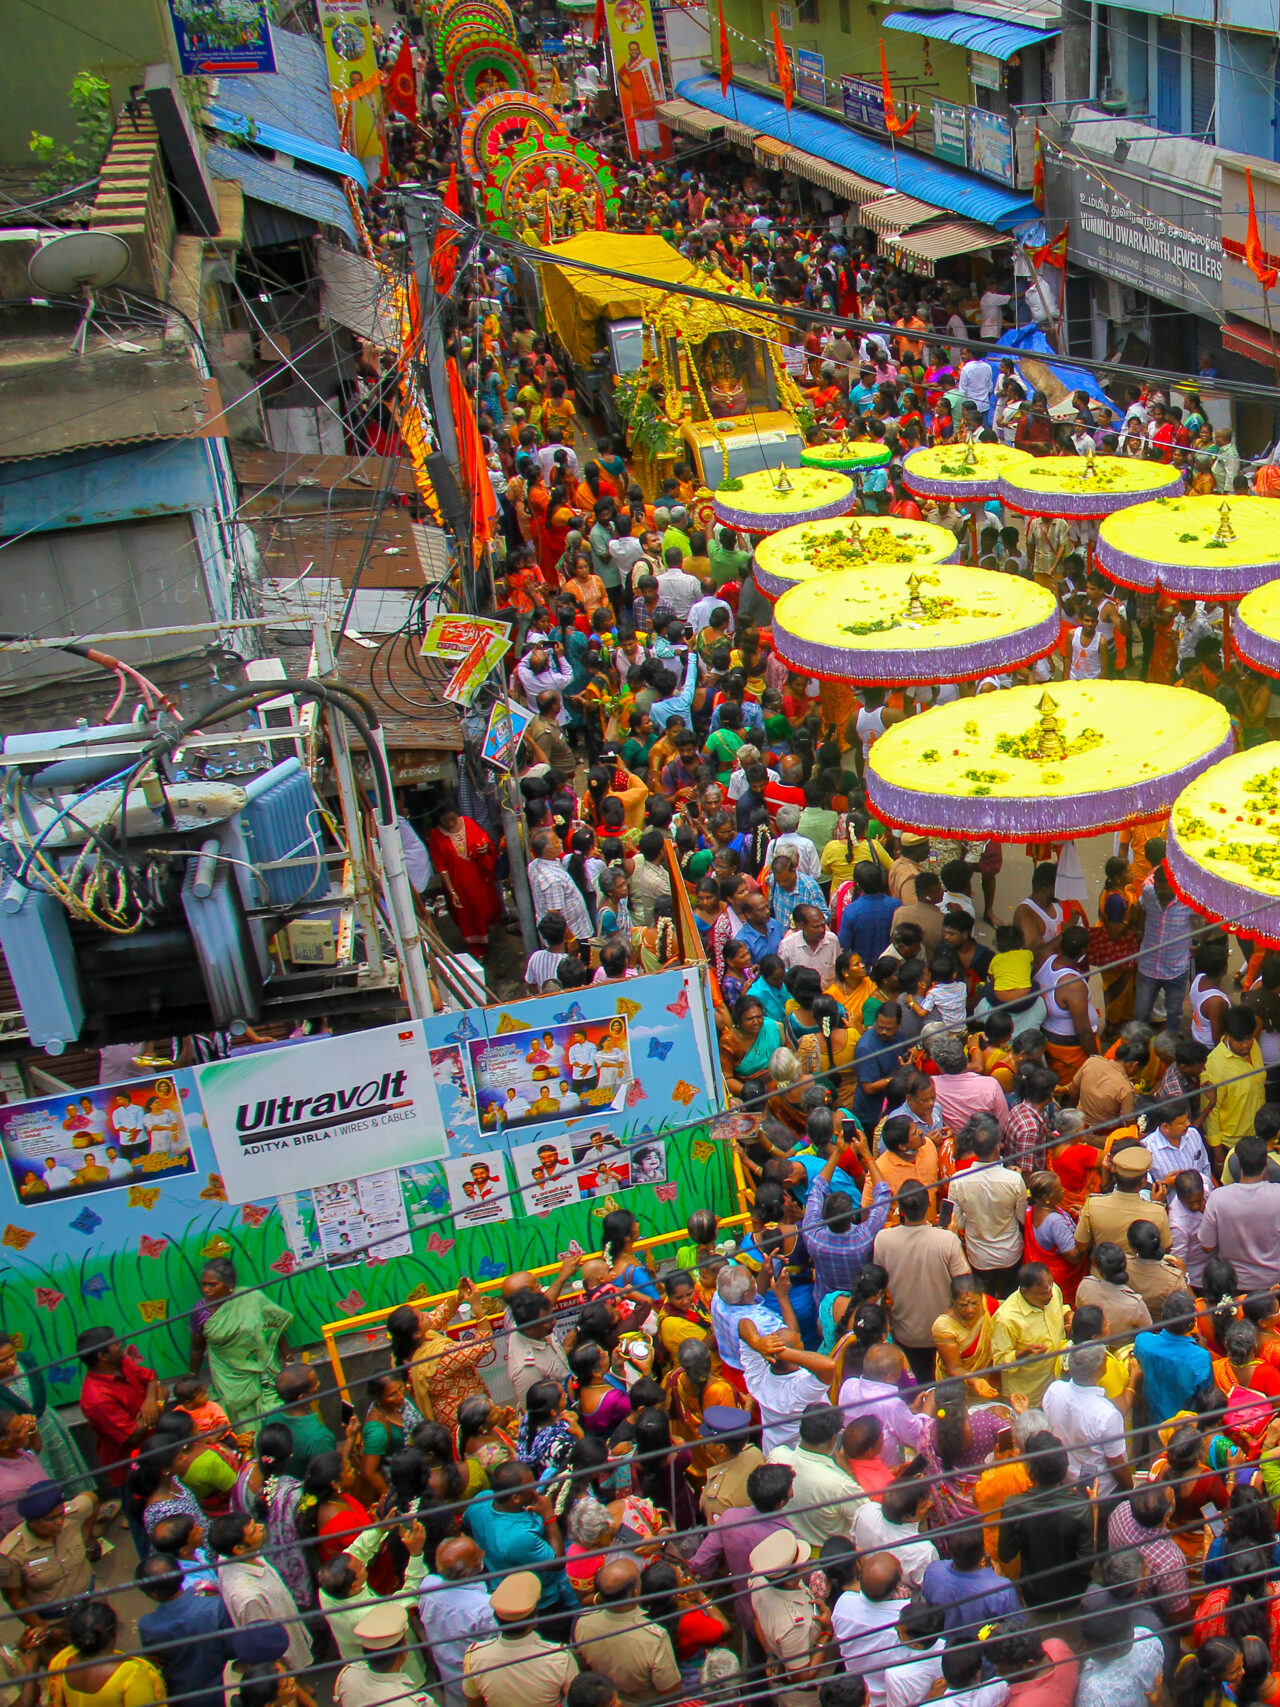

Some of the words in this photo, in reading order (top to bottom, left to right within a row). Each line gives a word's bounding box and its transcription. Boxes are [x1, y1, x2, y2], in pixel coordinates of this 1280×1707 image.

[1080, 211, 1114, 242] VUMMIDI
[1115, 223, 1171, 263] DWARKANATH
[1171, 244, 1223, 282] JEWELLERS
[234, 1069, 408, 1132] Ultravolt
[243, 1140, 289, 1157] ADITYA
[293, 1130, 332, 1146] BIRLA
[339, 1122, 369, 1136] WIRES
[371, 1118, 379, 1128] &
[381, 1108, 417, 1126] CABLES
[558, 1295, 588, 1309] TRAFC
